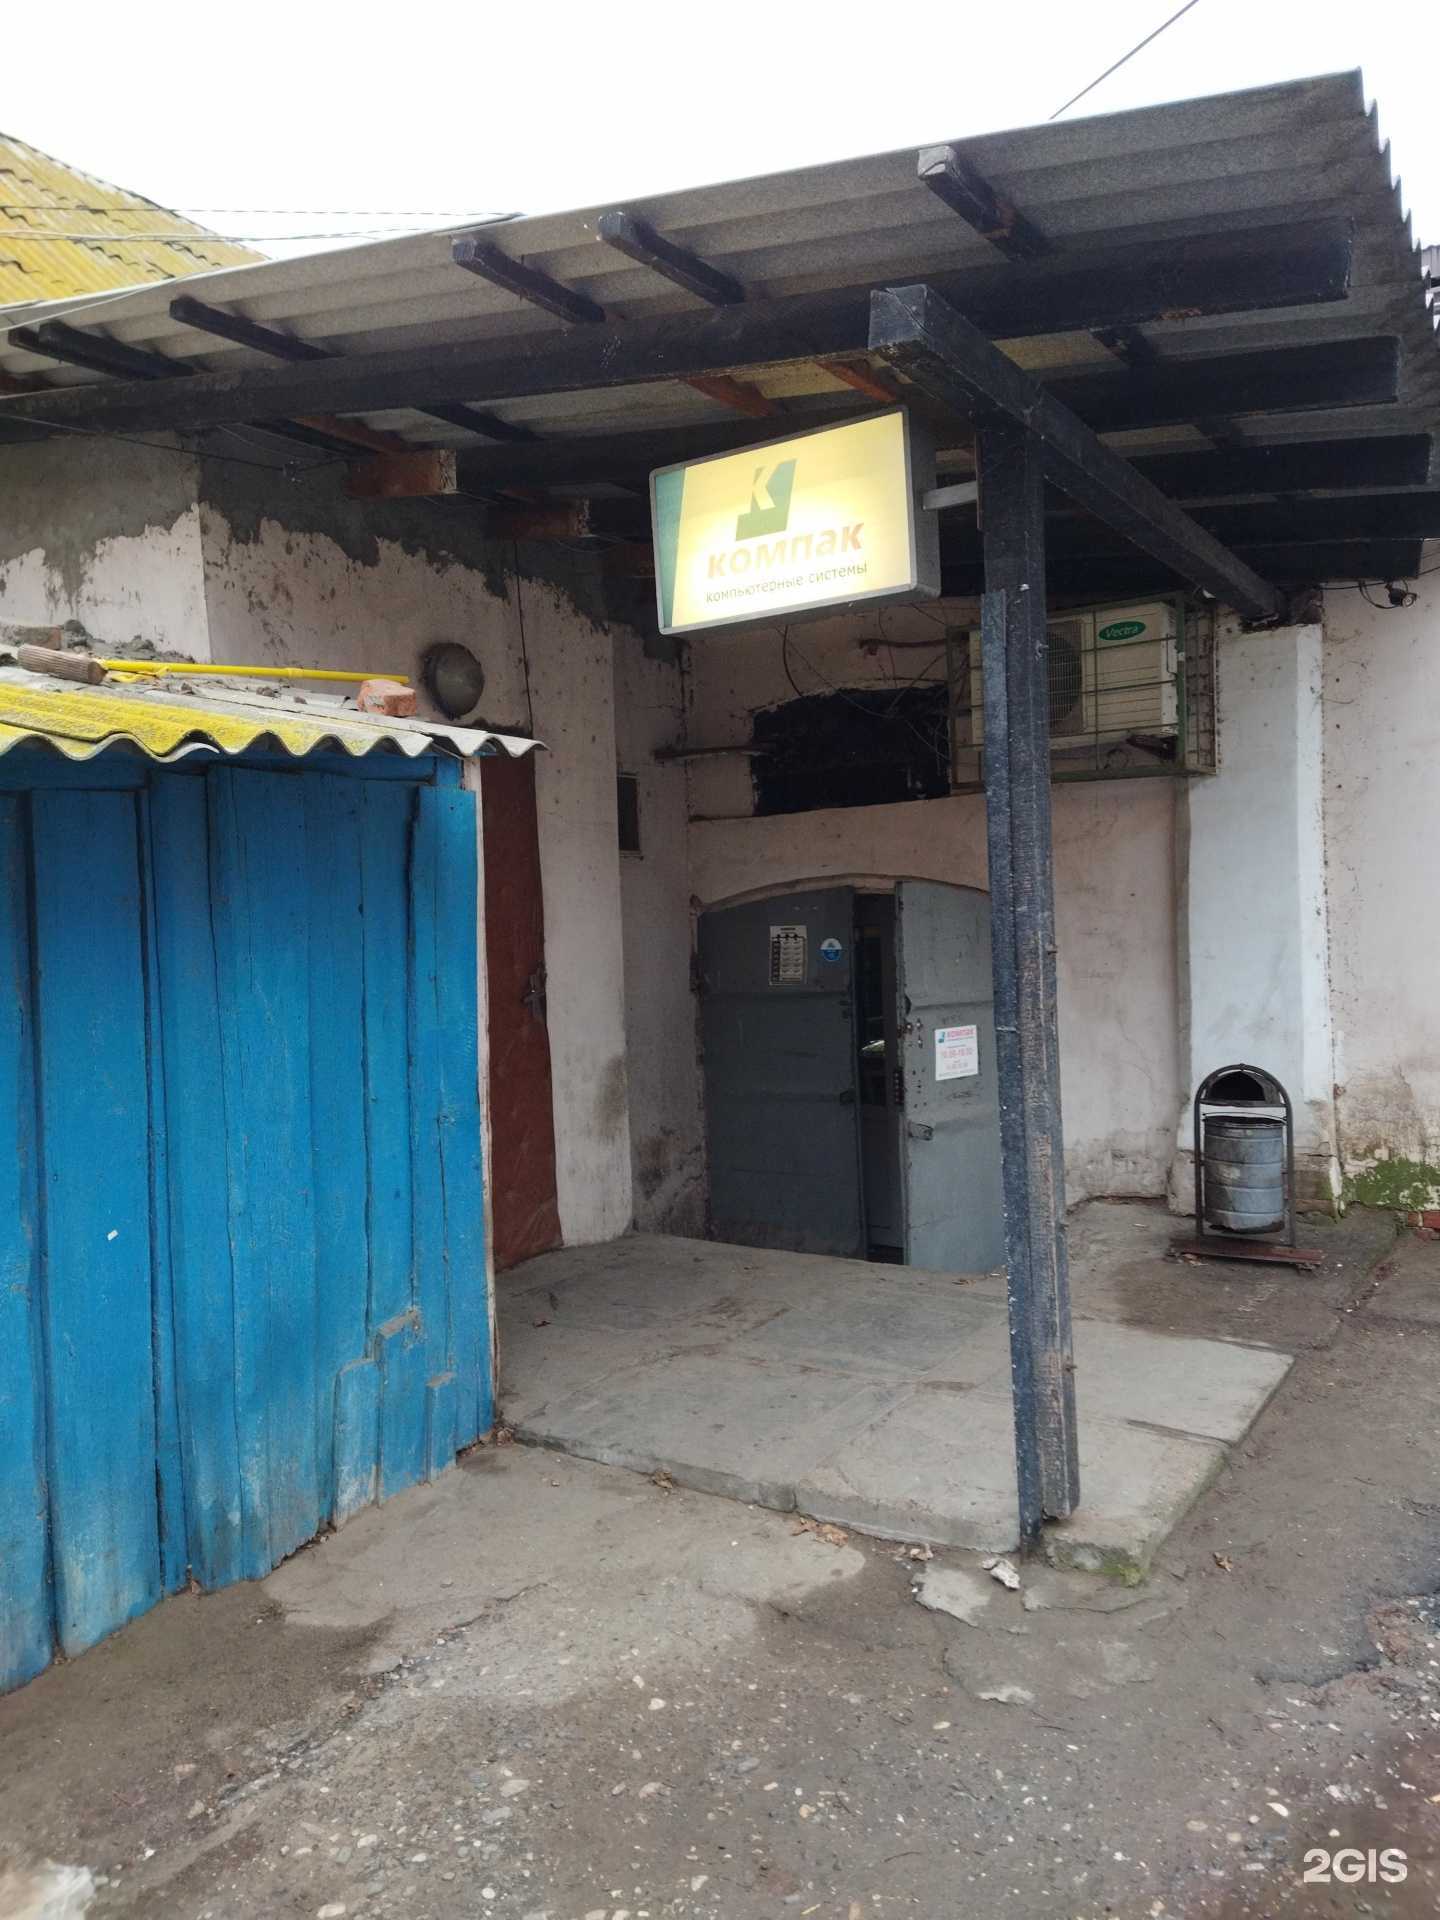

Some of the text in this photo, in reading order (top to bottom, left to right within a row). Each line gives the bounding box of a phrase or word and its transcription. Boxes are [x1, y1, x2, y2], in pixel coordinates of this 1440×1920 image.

[707, 522, 865, 580] компак
[706, 562, 868, 603] компьютерные системы
